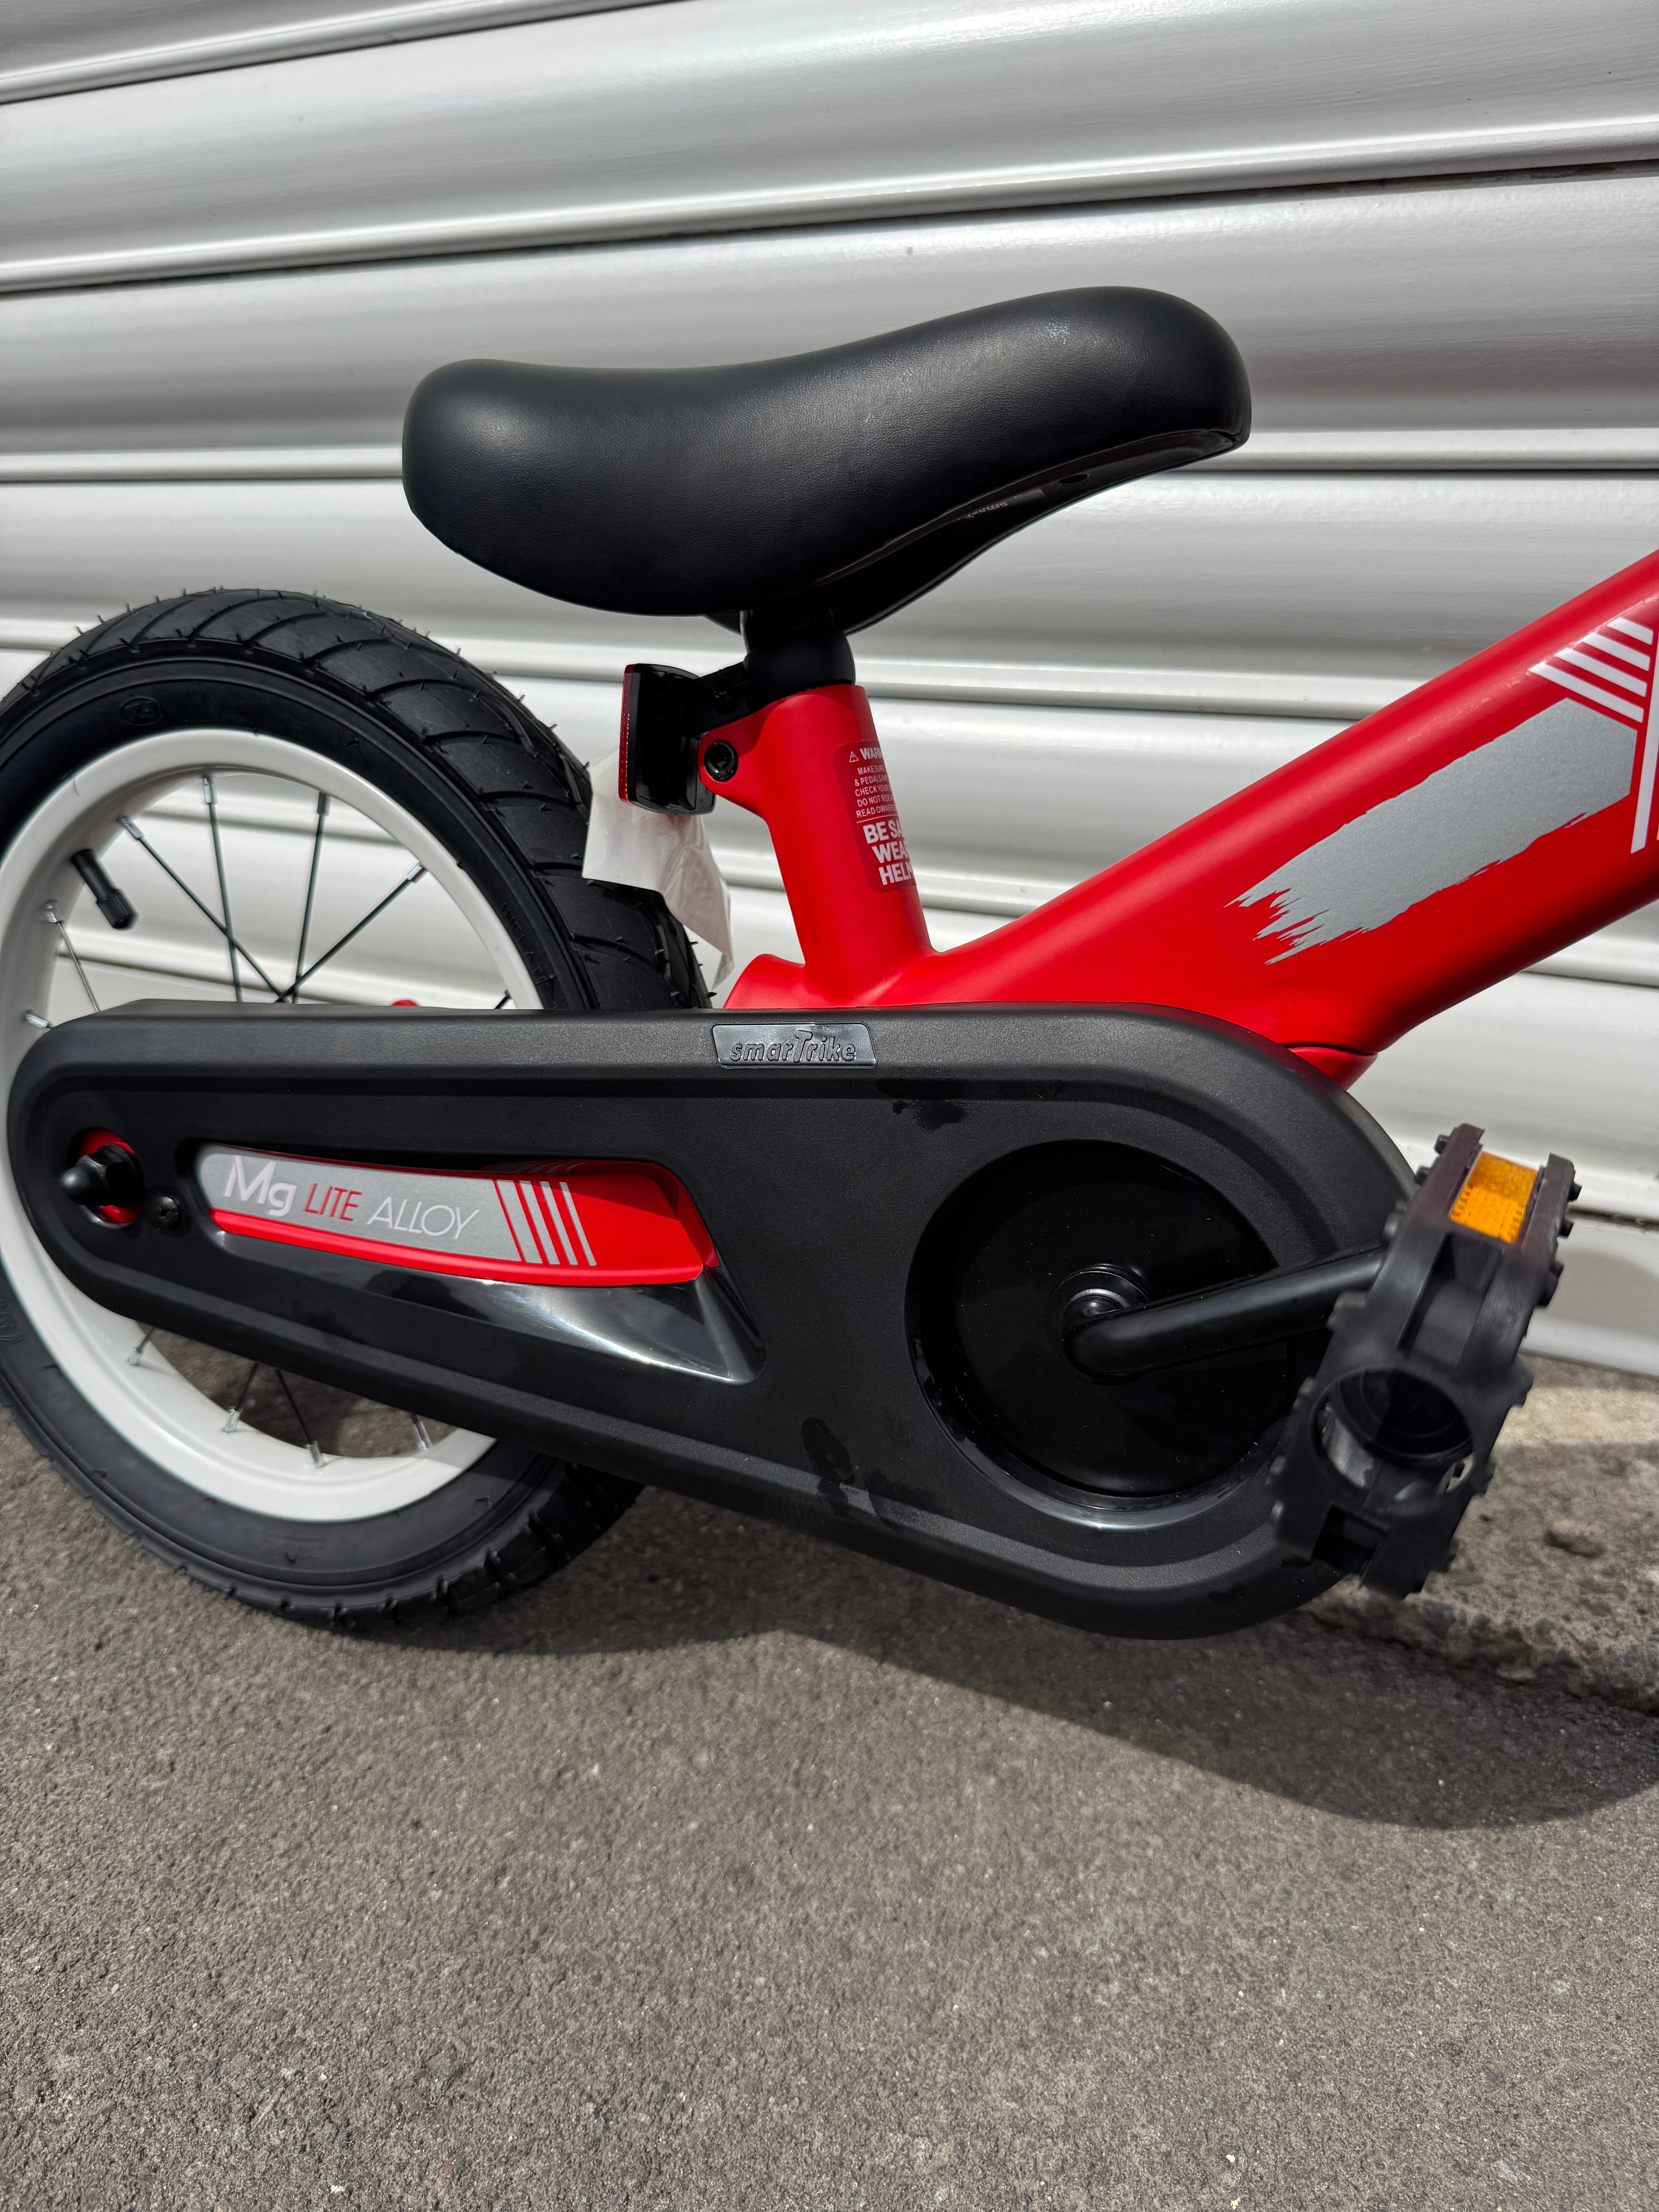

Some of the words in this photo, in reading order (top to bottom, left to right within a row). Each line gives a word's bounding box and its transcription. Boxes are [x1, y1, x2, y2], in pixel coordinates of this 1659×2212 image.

[857, 766, 875, 775] MAKE
[860, 776, 881, 785] PEDALS
[855, 785, 878, 797] CHECK
[857, 798, 868, 807] DO
[868, 795, 880, 805] NOT
[856, 807, 875, 818] READ
[863, 821, 889, 844] BE
[730, 1030, 856, 1063] smarTrike
[224, 1155, 297, 1217] Mg
[304, 1182, 363, 1222] LITE
[366, 1196, 480, 1239] ALLOY
